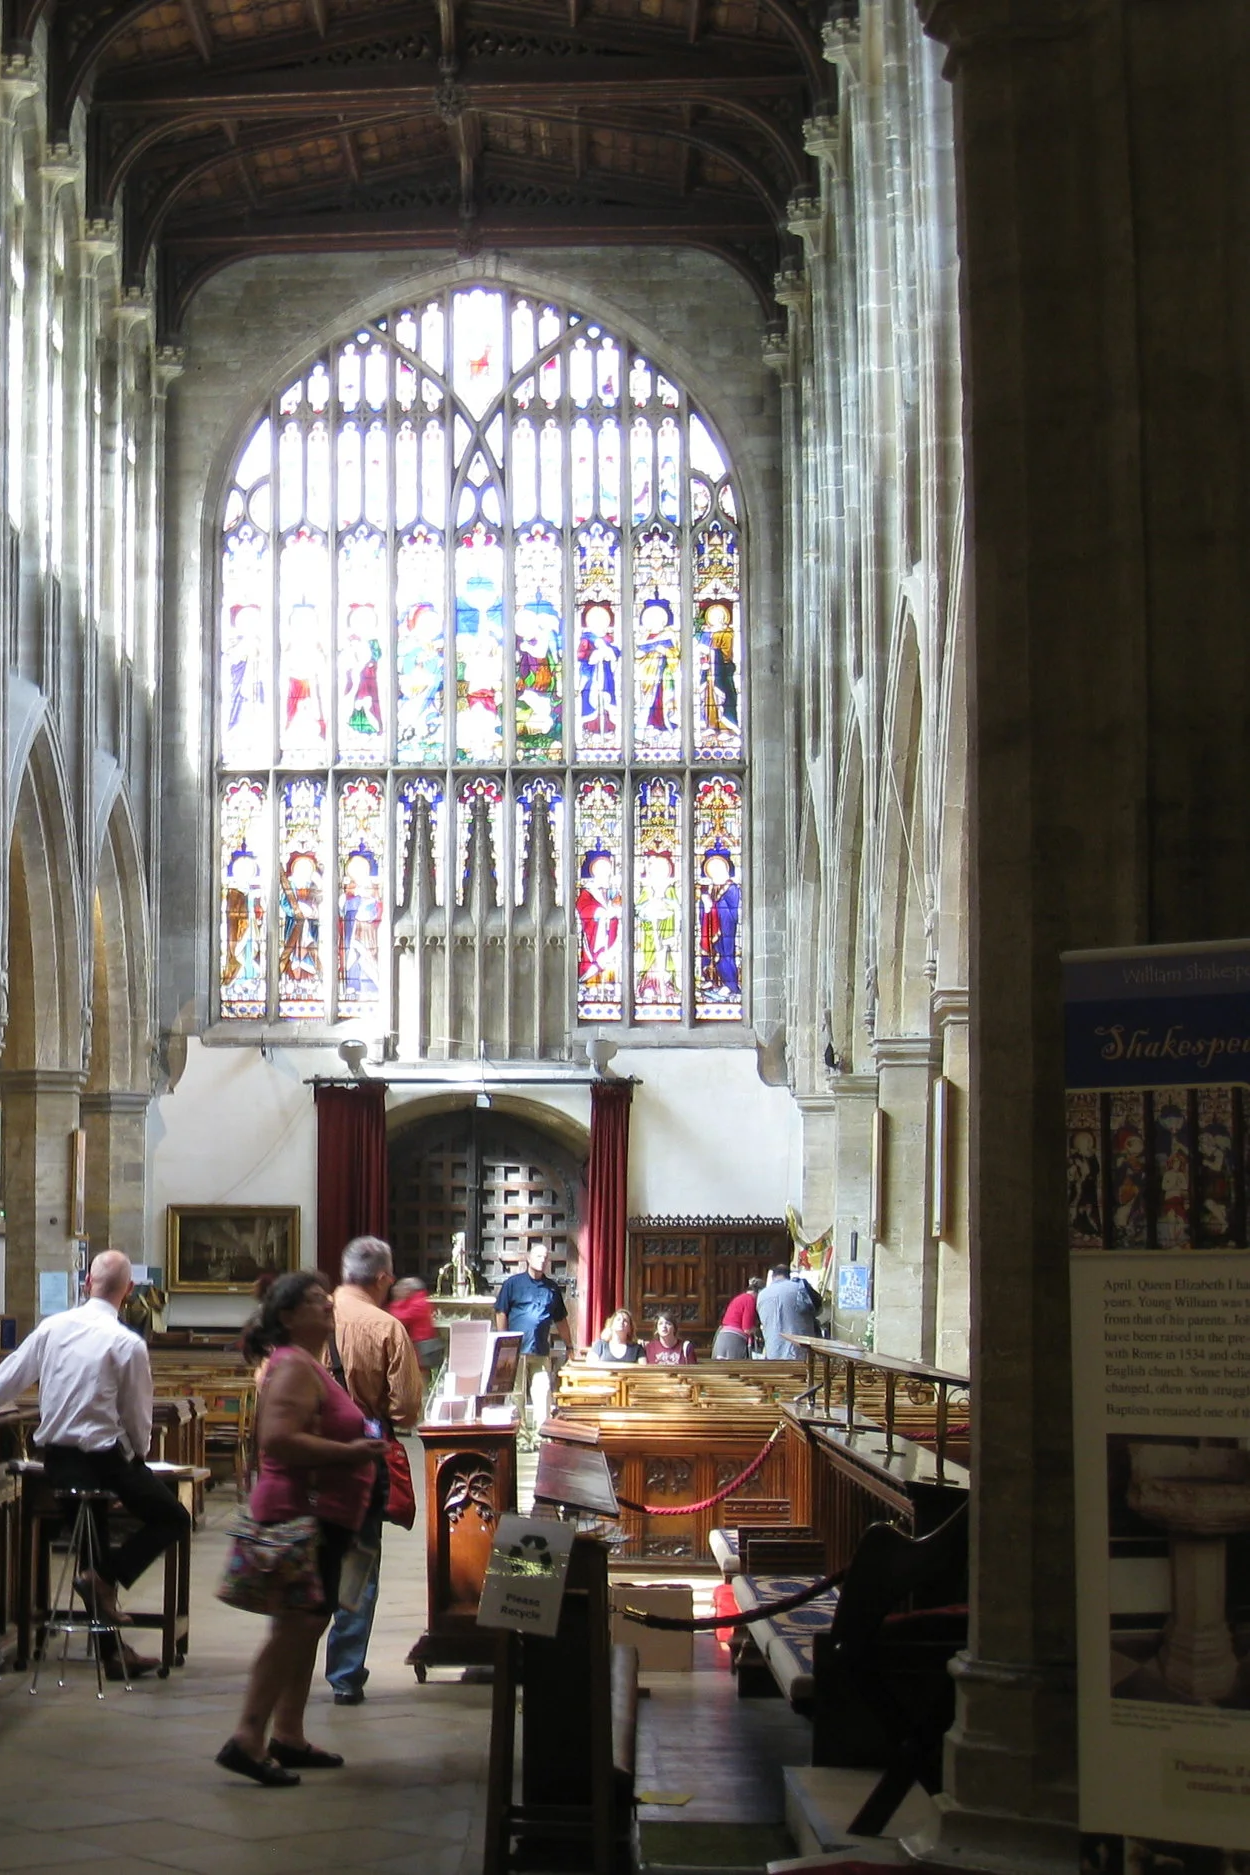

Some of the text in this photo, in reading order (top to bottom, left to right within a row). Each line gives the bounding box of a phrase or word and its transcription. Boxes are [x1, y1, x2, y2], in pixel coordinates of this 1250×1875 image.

[1123, 965, 1181, 984] William
[1138, 1280, 1171, 1292] Queen
[1175, 1279, 1224, 1290] Elizabeth
[1138, 1297, 1171, 1310] Young
[1175, 1297, 1217, 1308] William
[1221, 1299, 1242, 1308] was
[1104, 1313, 1130, 1325] from
[1133, 1313, 1152, 1325] that
[1155, 1313, 1167, 1325] of
[1169, 1314, 1184, 1325] his
[1105, 1331, 1130, 1342] have
[1133, 1331, 1157, 1342] been
[1160, 1331, 1191, 1343] raised
[1195, 1332, 1205, 1343] in
[1208, 1333, 1224, 1343] the
[1105, 1348, 1128, 1359] with
[1132, 1348, 1162, 1360] Rome
[1166, 1349, 1176, 1360] in
[1180, 1349, 1204, 1360] 1534
[1209, 1350, 1228, 1361] and
[1105, 1365, 1146, 1379] English
[1190, 1366, 1220, 1378] Some
[1156, 1384, 1181, 1395] often
[1186, 1384, 1208, 1396] with
[1106, 1403, 1149, 1417] Baptism
[1153, 1405, 1200, 1418] remained
[1204, 1409, 1223, 1418] one
[1226, 1408, 1238, 1418] of
[505, 1593, 540, 1607] Please
[500, 1605, 541, 1620] Recycle
